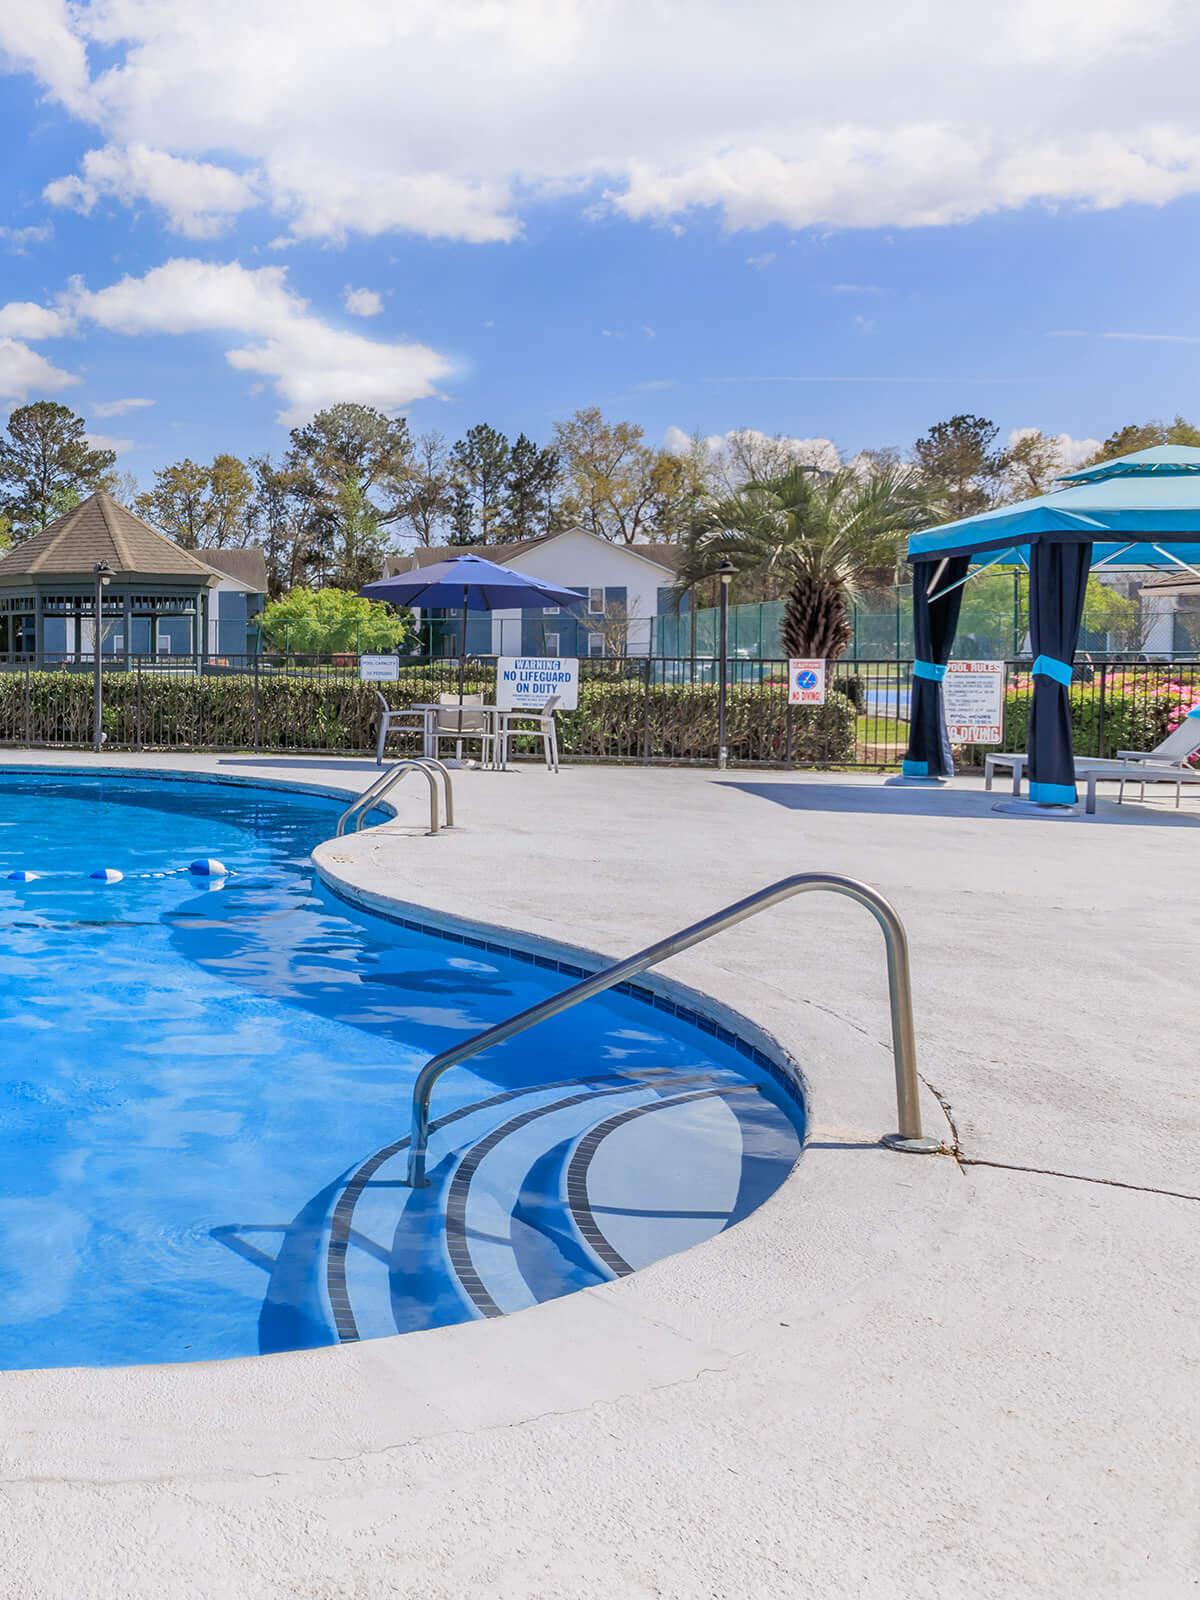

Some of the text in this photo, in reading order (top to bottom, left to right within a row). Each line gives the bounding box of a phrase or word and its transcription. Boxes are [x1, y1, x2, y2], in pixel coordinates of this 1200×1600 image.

[515, 659, 560, 670] WARNING
[970, 663, 1000, 672] RULES
[503, 670, 572, 682] NO LIFEGUARD
[516, 682, 558, 694] ON DUTY
